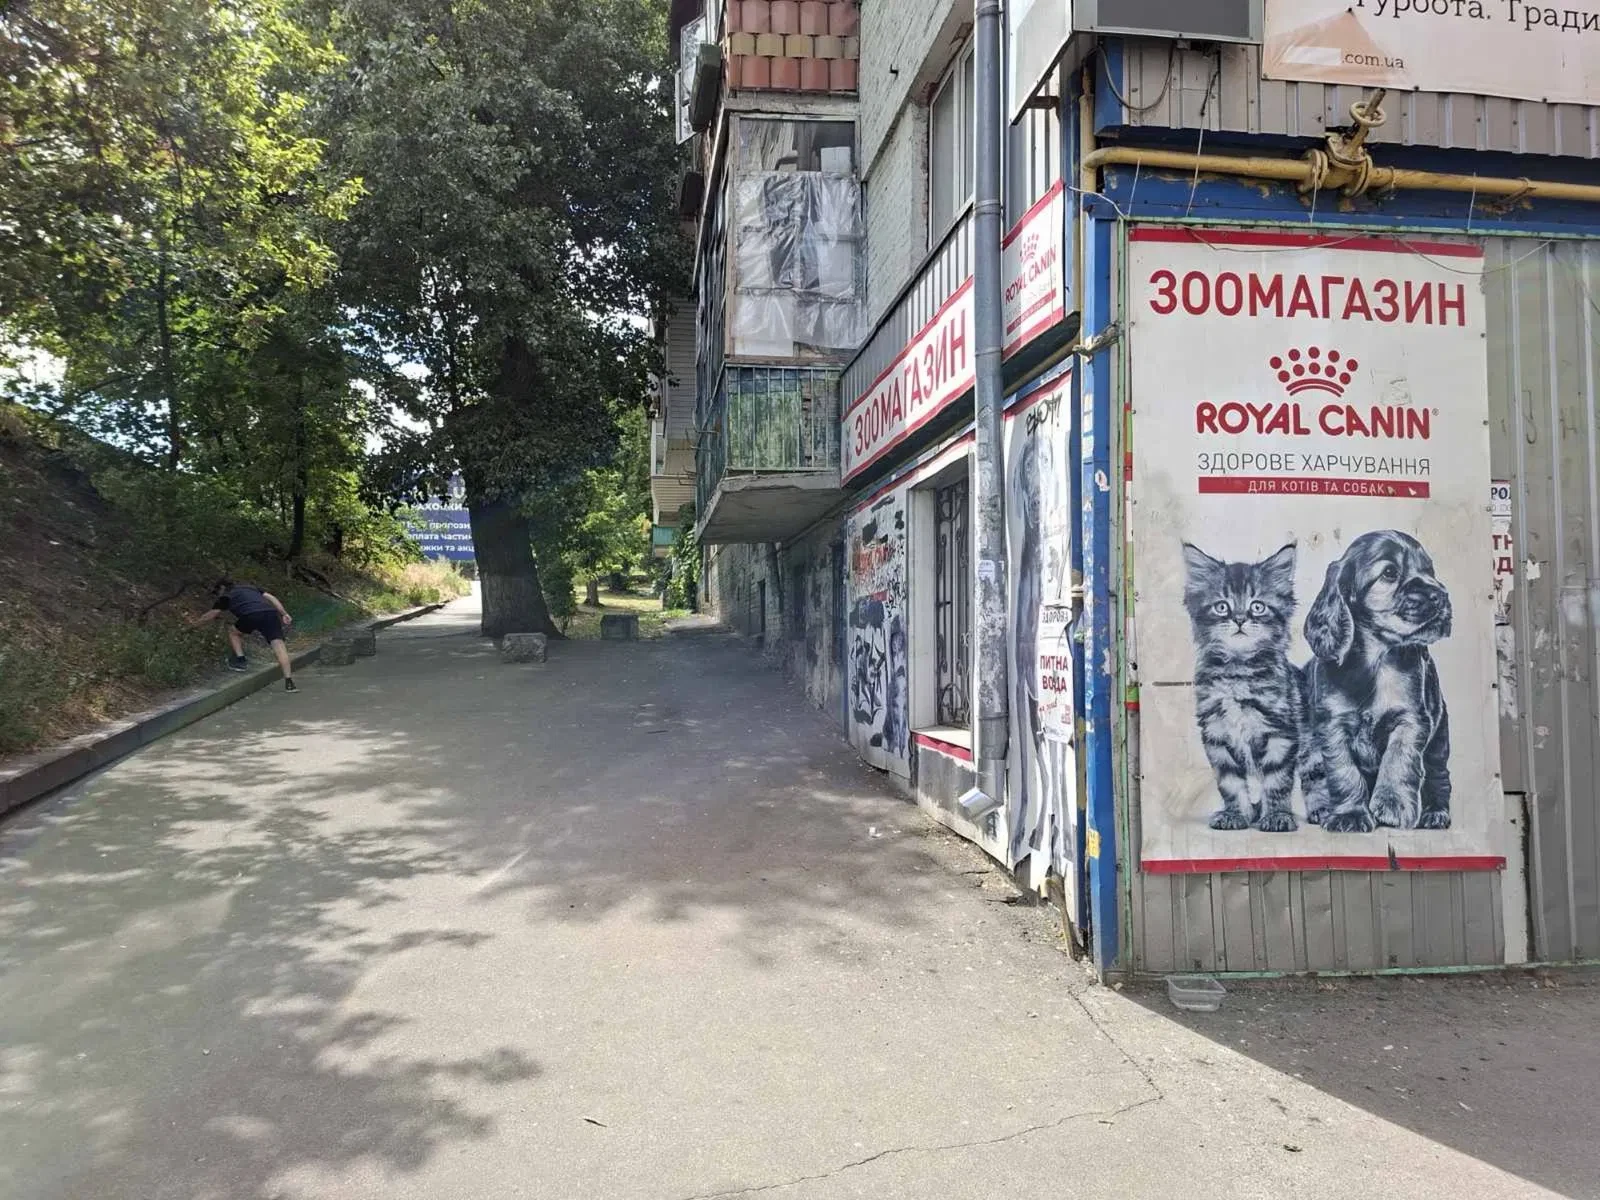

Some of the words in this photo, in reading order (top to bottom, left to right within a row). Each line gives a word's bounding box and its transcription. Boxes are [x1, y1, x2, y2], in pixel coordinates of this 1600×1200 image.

[1356, 0, 1492, 20] урбота.
[1005, 272, 1028, 305] ROYAL
[1028, 245, 1056, 283] CANIN
[1149, 269, 1466, 327] ЗООМАГАЗИН
[854, 308, 966, 457] ЗООМАГАЗИН
[1196, 401, 1311, 435] ROYAL
[1197, 452, 1296, 475] ЗДОРОВЕ
[1301, 453, 1431, 476] ХАРЧУВАННЯ
[1247, 479, 1277, 493] ДЛЯ
[1281, 480, 1319, 493] КОТІВ
[1323, 481, 1339, 494] ТА
[1342, 482, 1386, 496] СОБАК
[1039, 655, 1069, 672] ПИТНА
[1042, 675, 1068, 695] ВОДА
